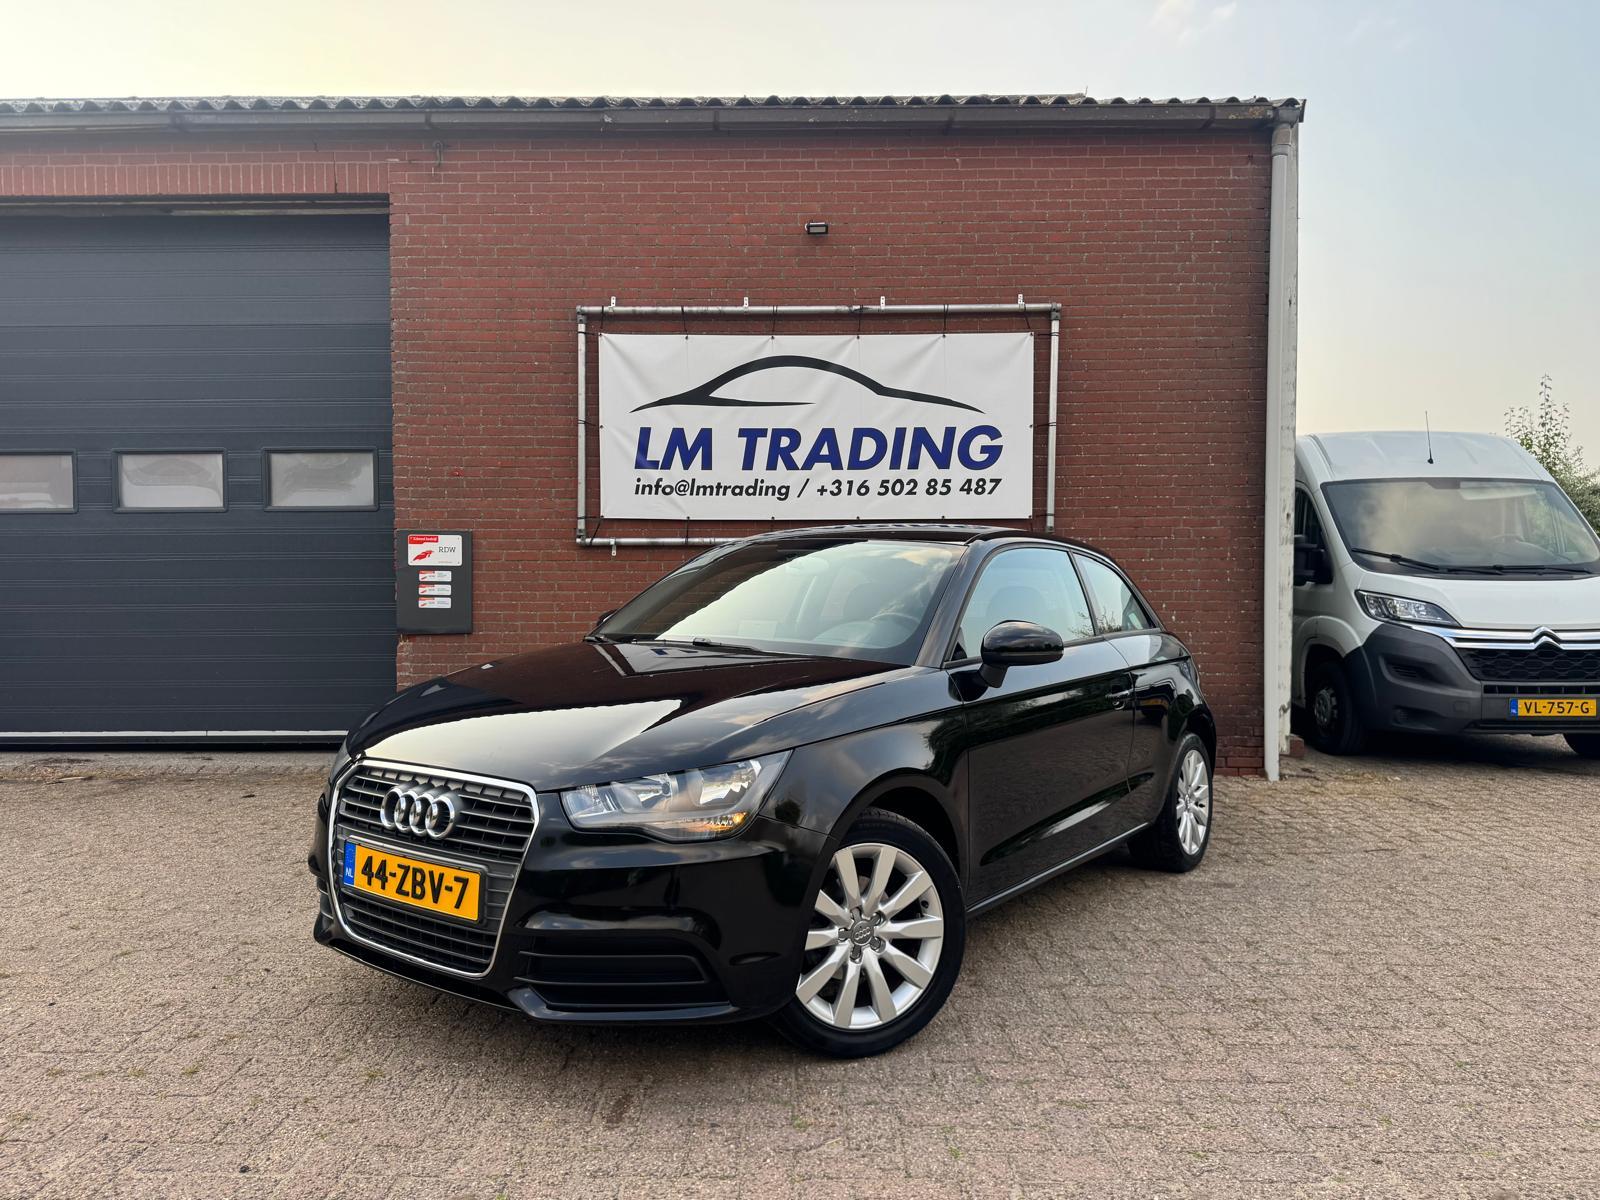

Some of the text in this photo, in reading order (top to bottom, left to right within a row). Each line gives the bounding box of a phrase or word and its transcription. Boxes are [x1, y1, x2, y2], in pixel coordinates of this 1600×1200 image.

[634, 424, 1004, 471] LM TRADING
[634, 477, 1002, 501] info@lmtrading / +316 502 85 487
[1524, 702, 1590, 714] VL-757-G
[345, 867, 354, 879] NL
[361, 855, 469, 909] 44-ZBV-7
